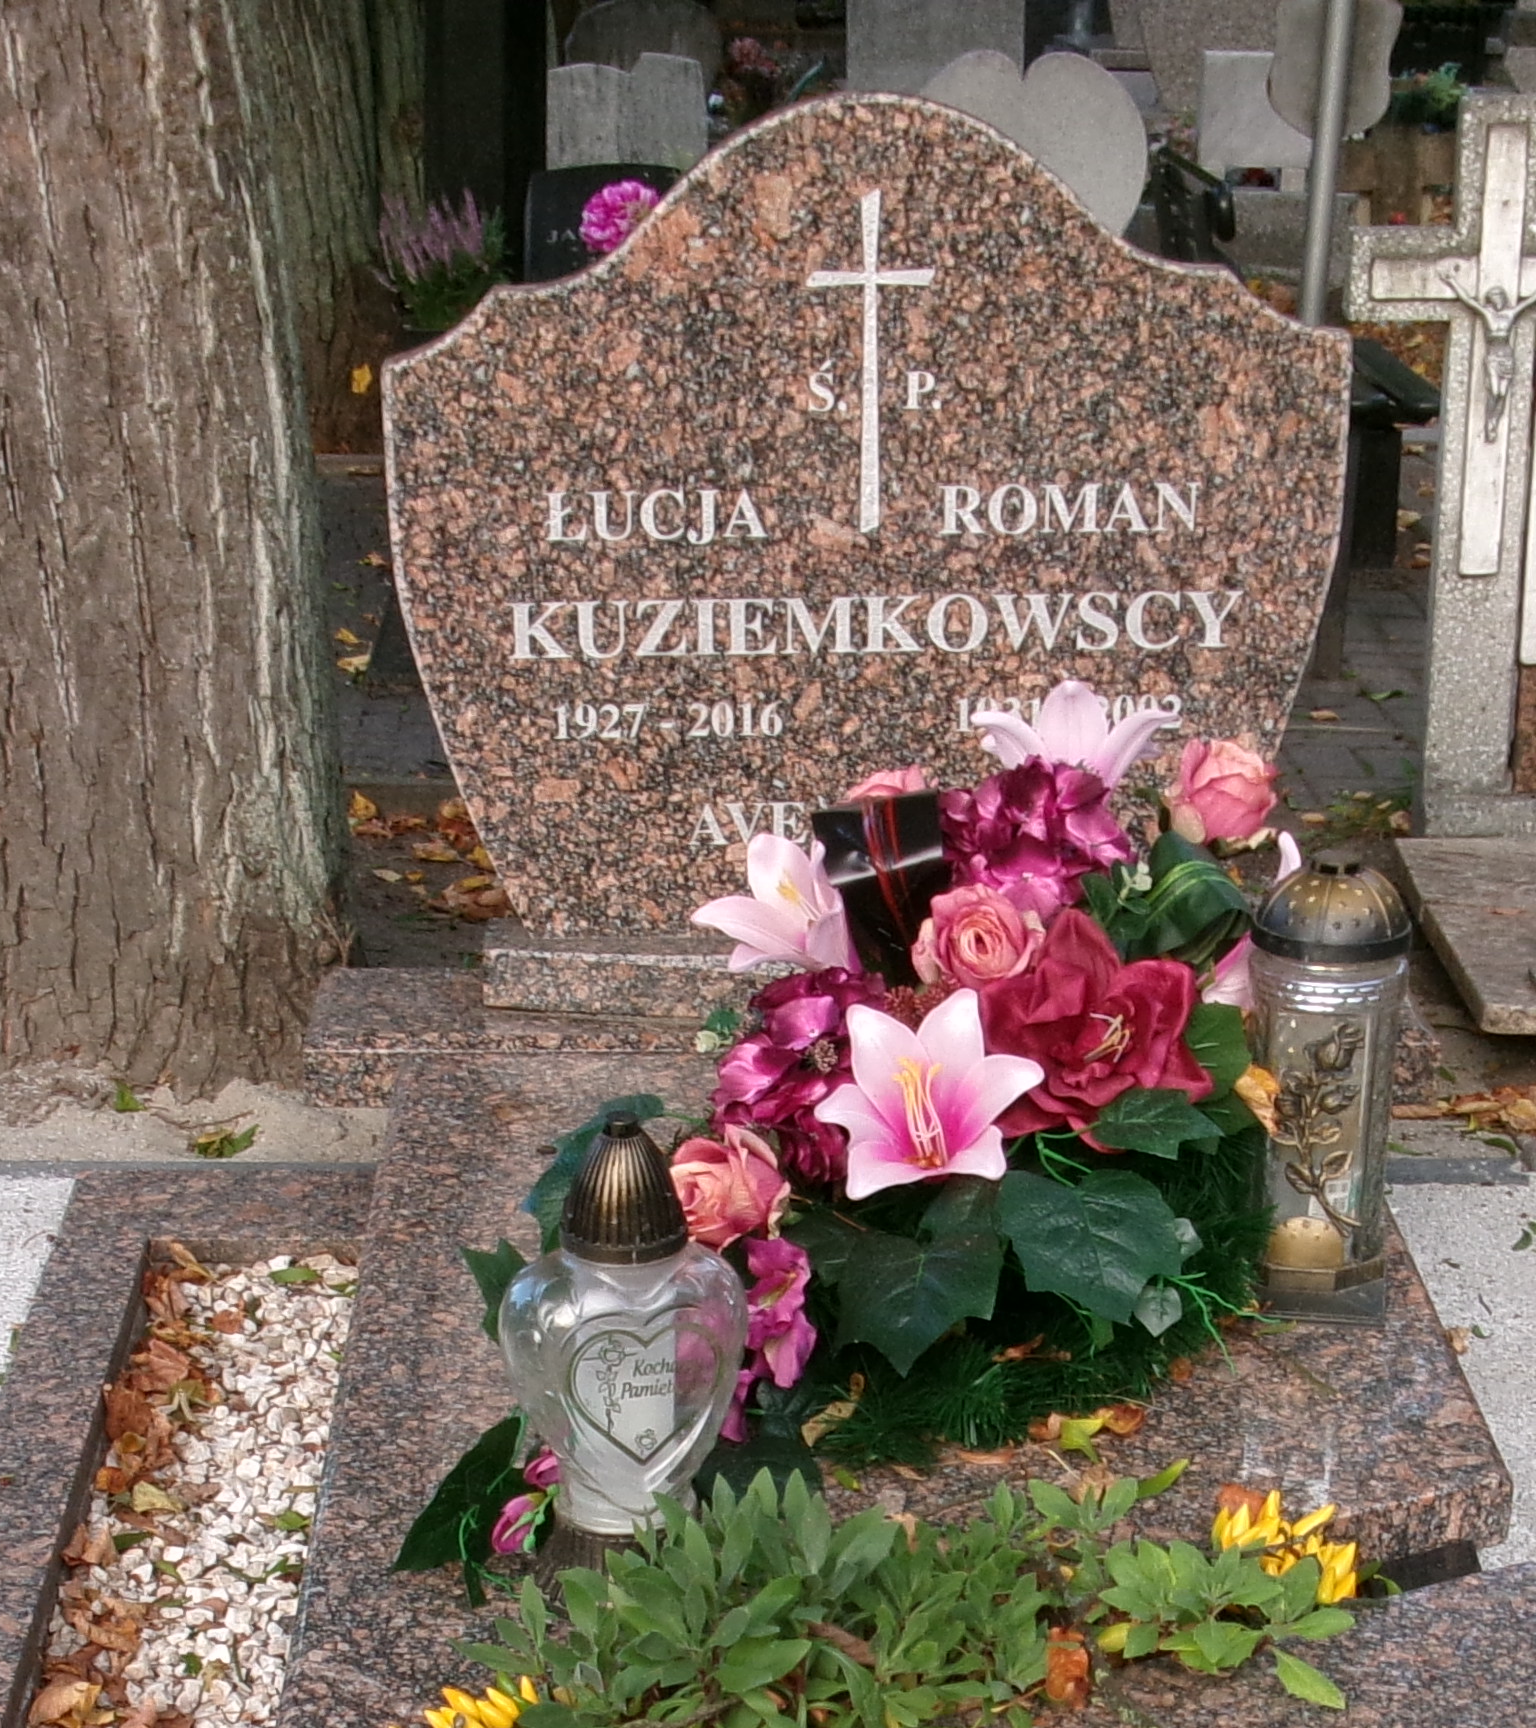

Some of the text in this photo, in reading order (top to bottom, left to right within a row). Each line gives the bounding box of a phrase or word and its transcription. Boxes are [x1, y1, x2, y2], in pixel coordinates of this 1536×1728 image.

[808, 360, 942, 412] Ś. P.
[544, 481, 1200, 545] ŁUCJA ROMAN
[511, 590, 1245, 661] KUZIEMKOWSCY
[552, 702, 648, 740] 1927
[684, 700, 784, 737] 2016
[688, 800, 810, 846] AVE
